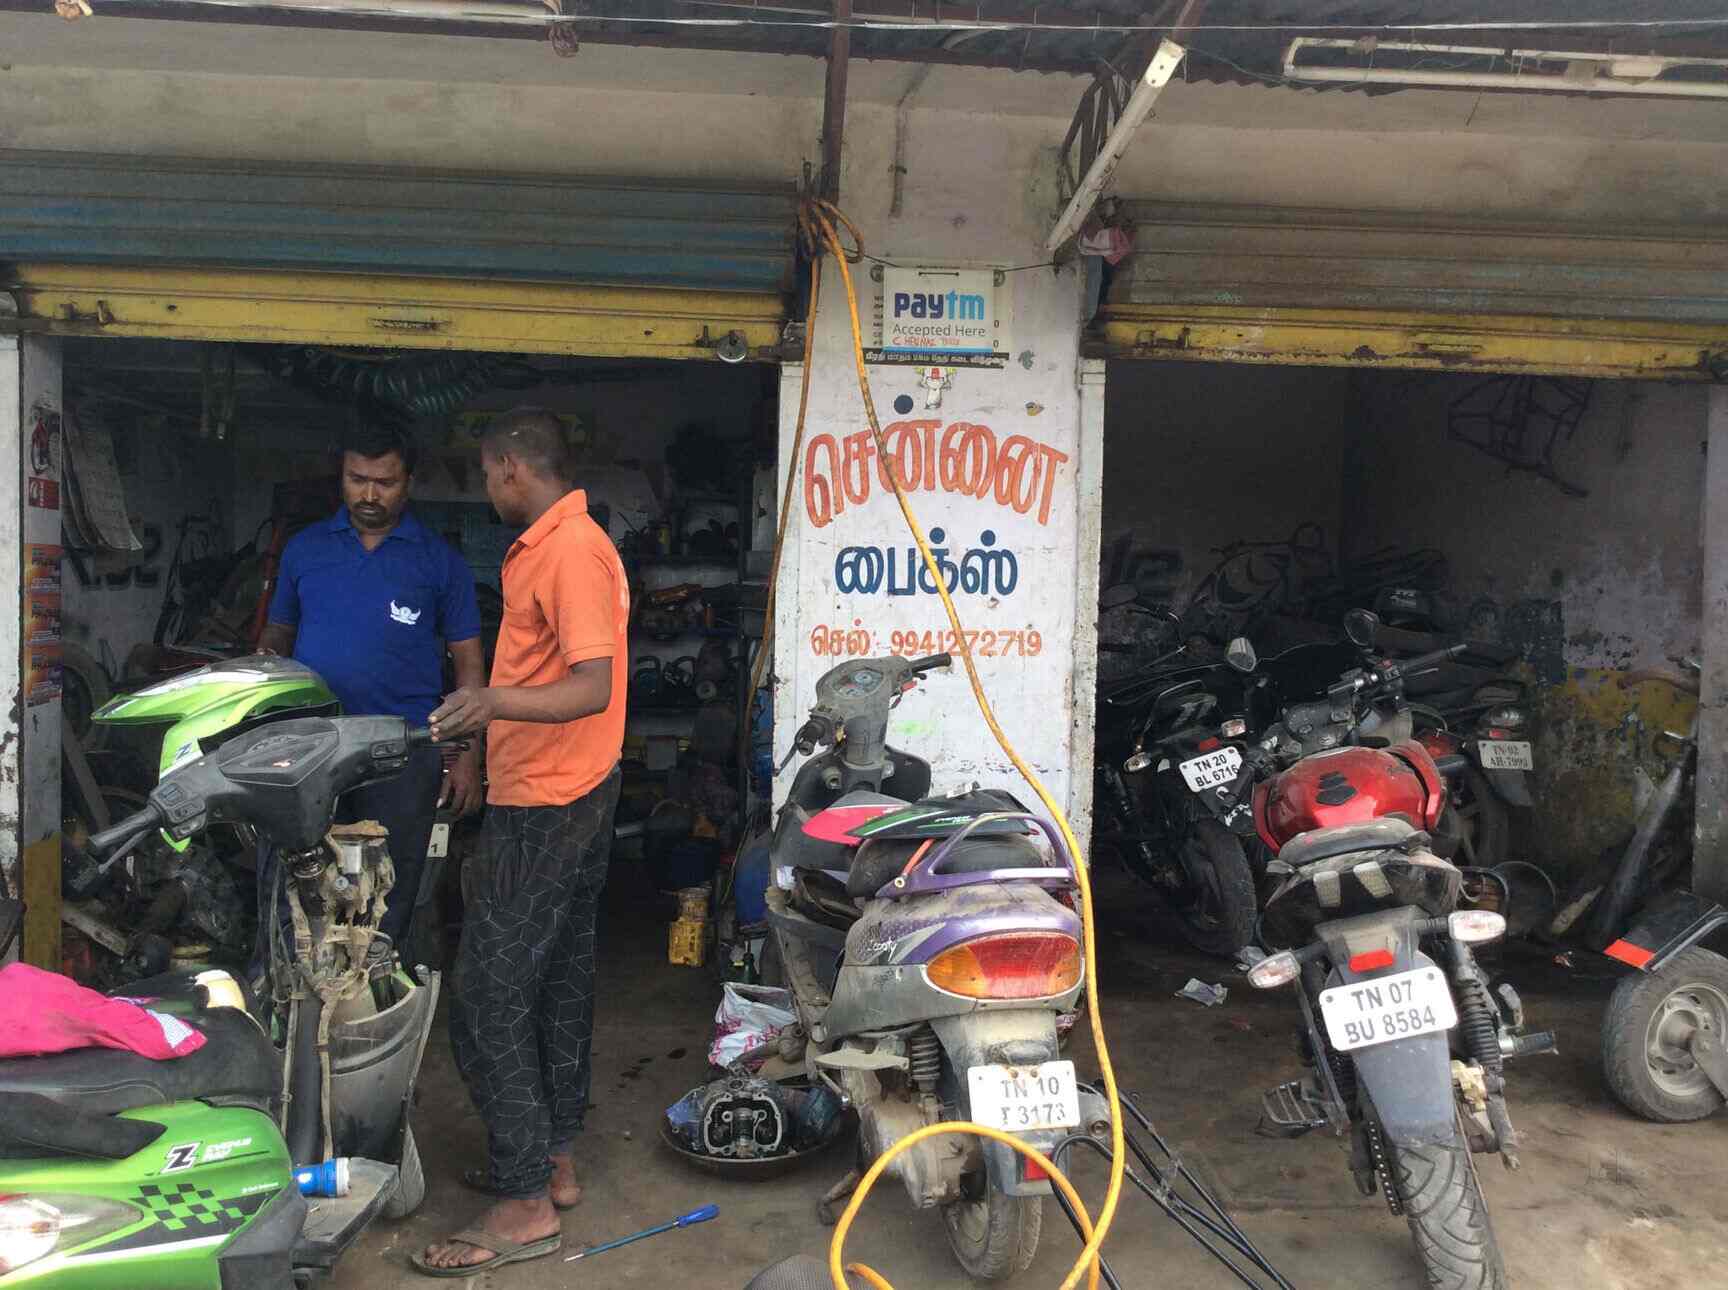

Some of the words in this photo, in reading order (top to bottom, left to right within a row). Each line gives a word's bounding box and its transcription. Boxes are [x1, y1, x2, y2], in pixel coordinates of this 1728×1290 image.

[892, 324, 951, 337] Accepted
[955, 327, 986, 337] Here
[804, 395, 1068, 528] சென்னை
[835, 527, 1018, 596] பைக்ஸ்
[891, 629, 1042, 656] 9941272719
[1194, 759, 1212, 773] TN
[1212, 754, 1227, 766] 20
[1195, 774, 1211, 787] BL
[1212, 764, 1239, 781] 6716
[1351, 986, 1383, 1011] TN
[1388, 980, 1413, 1004] 07
[1344, 1018, 1375, 1044] BU
[1382, 1005, 1436, 1035] 8584
[1000, 1078, 1028, 1098] TN
